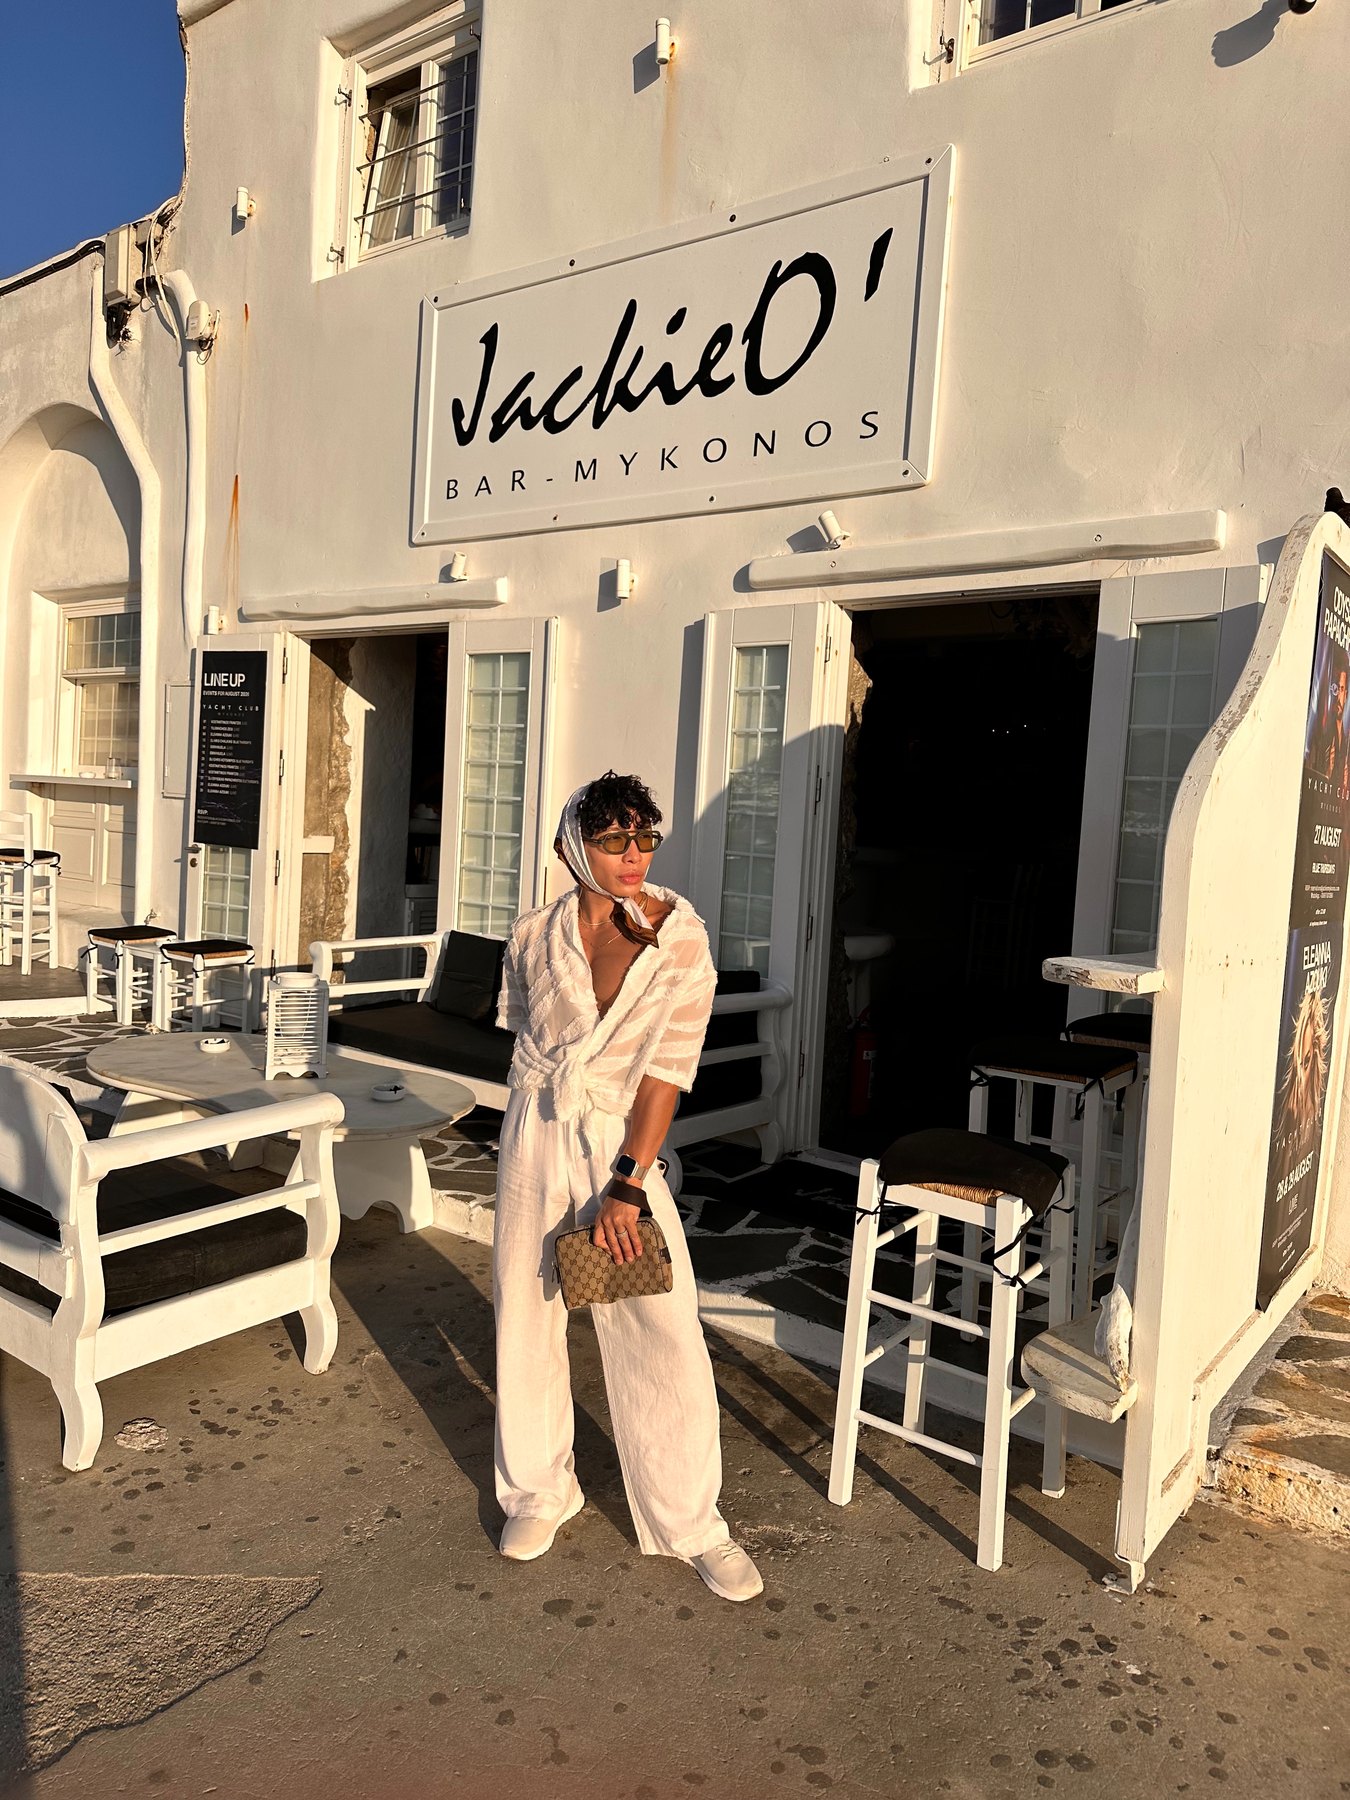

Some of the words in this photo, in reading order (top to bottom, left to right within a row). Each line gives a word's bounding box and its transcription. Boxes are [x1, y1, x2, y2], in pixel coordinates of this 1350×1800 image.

[1308, 777, 1333, 795] YACHT
[1313, 825, 1321, 845] 27
[1320, 826, 1342, 847] AUGUST
[1303, 941, 1331, 970] ELEANNA
